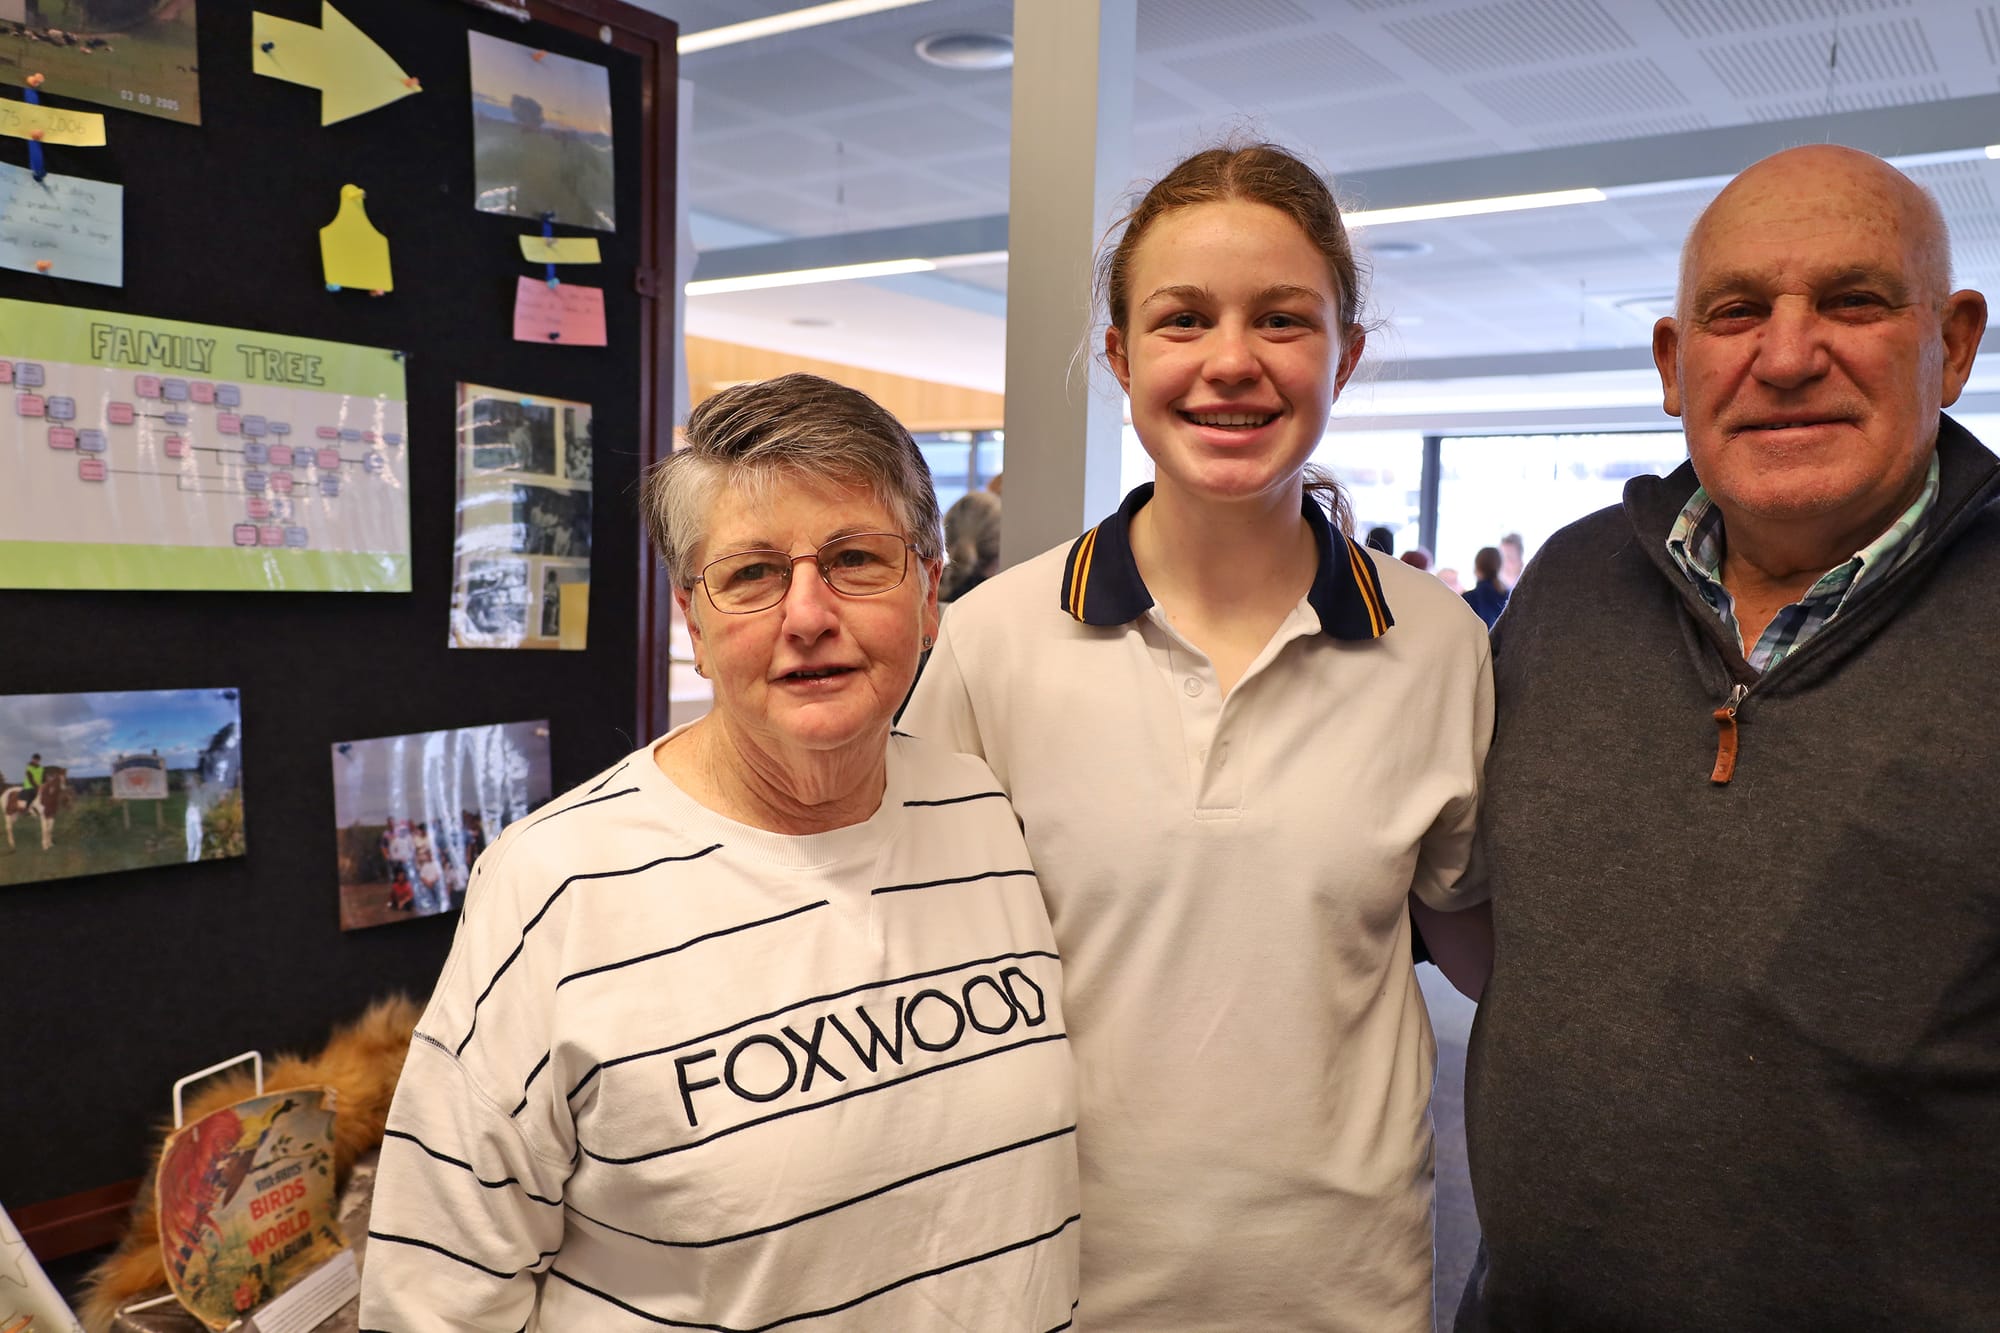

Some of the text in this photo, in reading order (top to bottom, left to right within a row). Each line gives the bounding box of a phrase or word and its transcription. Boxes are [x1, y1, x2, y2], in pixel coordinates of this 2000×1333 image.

[91, 323, 216, 373] FAMILY
[236, 344, 325, 386] TREE
[674, 967, 1046, 1127] FOXWOOD
[250, 1177, 307, 1221] BIRDS
[247, 1210, 311, 1257] WORLD
